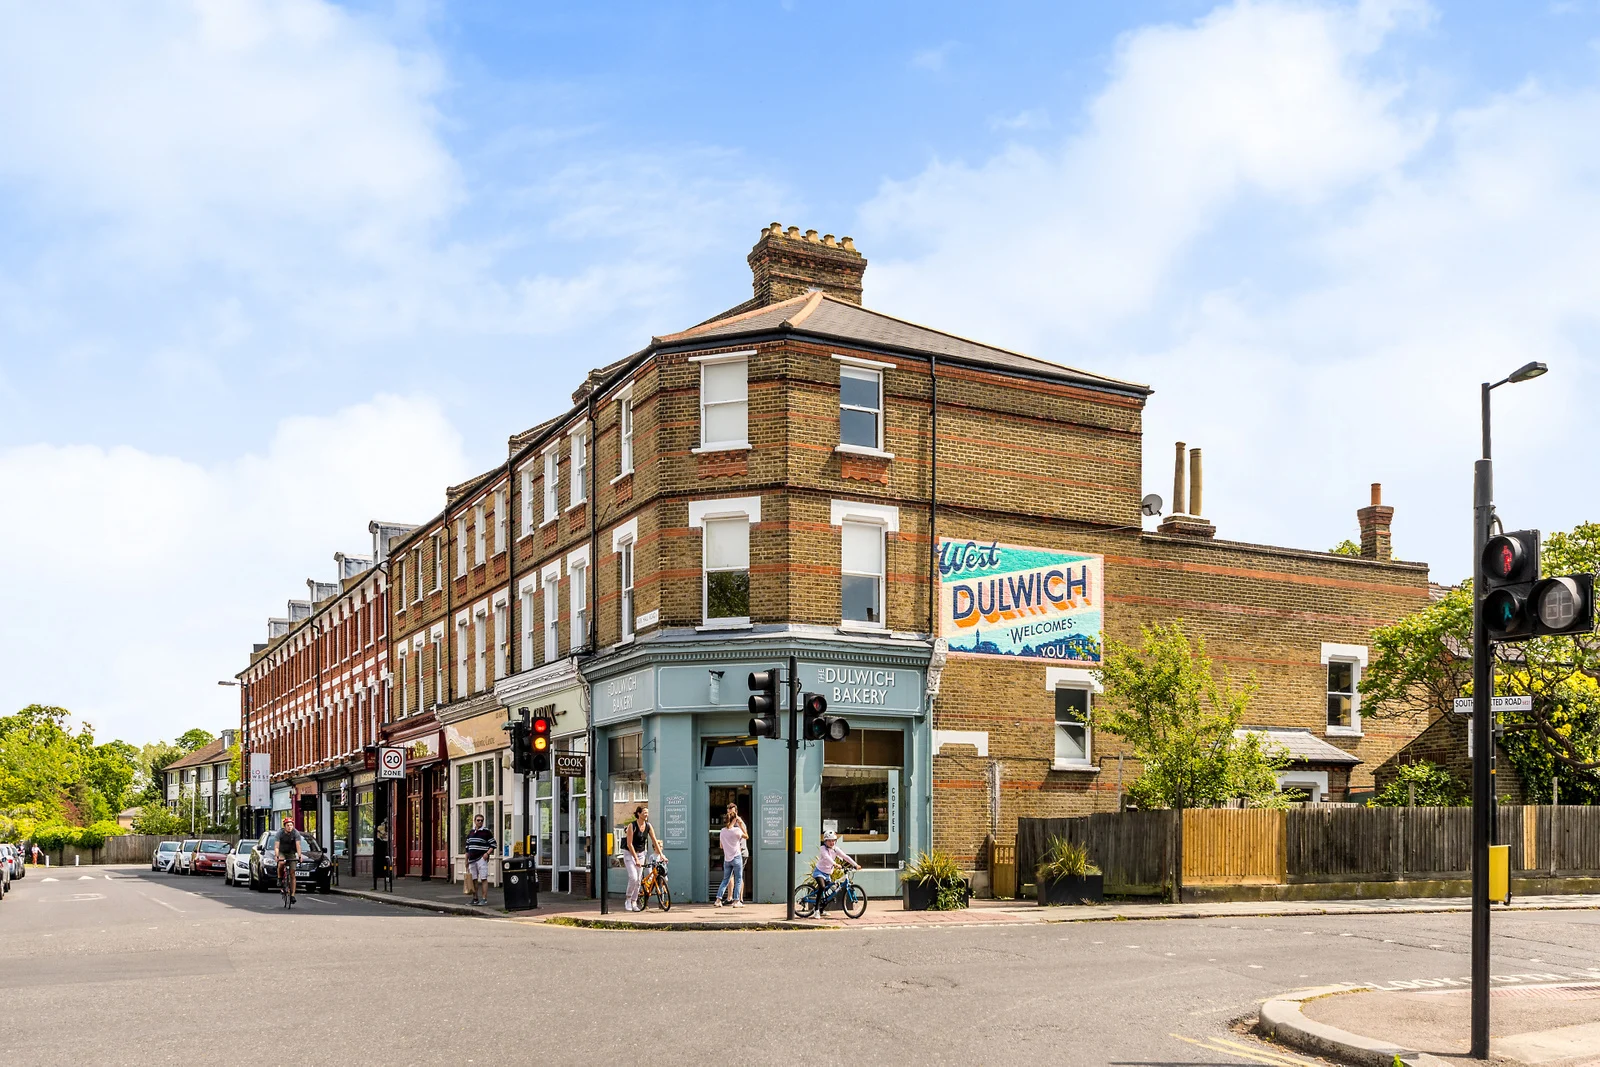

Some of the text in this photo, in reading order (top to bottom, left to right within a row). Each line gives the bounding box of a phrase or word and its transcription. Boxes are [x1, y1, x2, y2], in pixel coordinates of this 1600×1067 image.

[934, 541, 1001, 575] West
[952, 564, 1088, 621] DULWICH
[1010, 618, 1073, 644] WELCOMES
[1041, 645, 1066, 658] YOU
[610, 675, 637, 696] DULWICH
[825, 668, 895, 687] DULWICH
[613, 694, 634, 713] BAKERY
[833, 687, 888, 705] BAKERY
[1505, 697, 1522, 706] ROAD
[386, 755, 400, 764] 20
[557, 757, 583, 767] COOK
